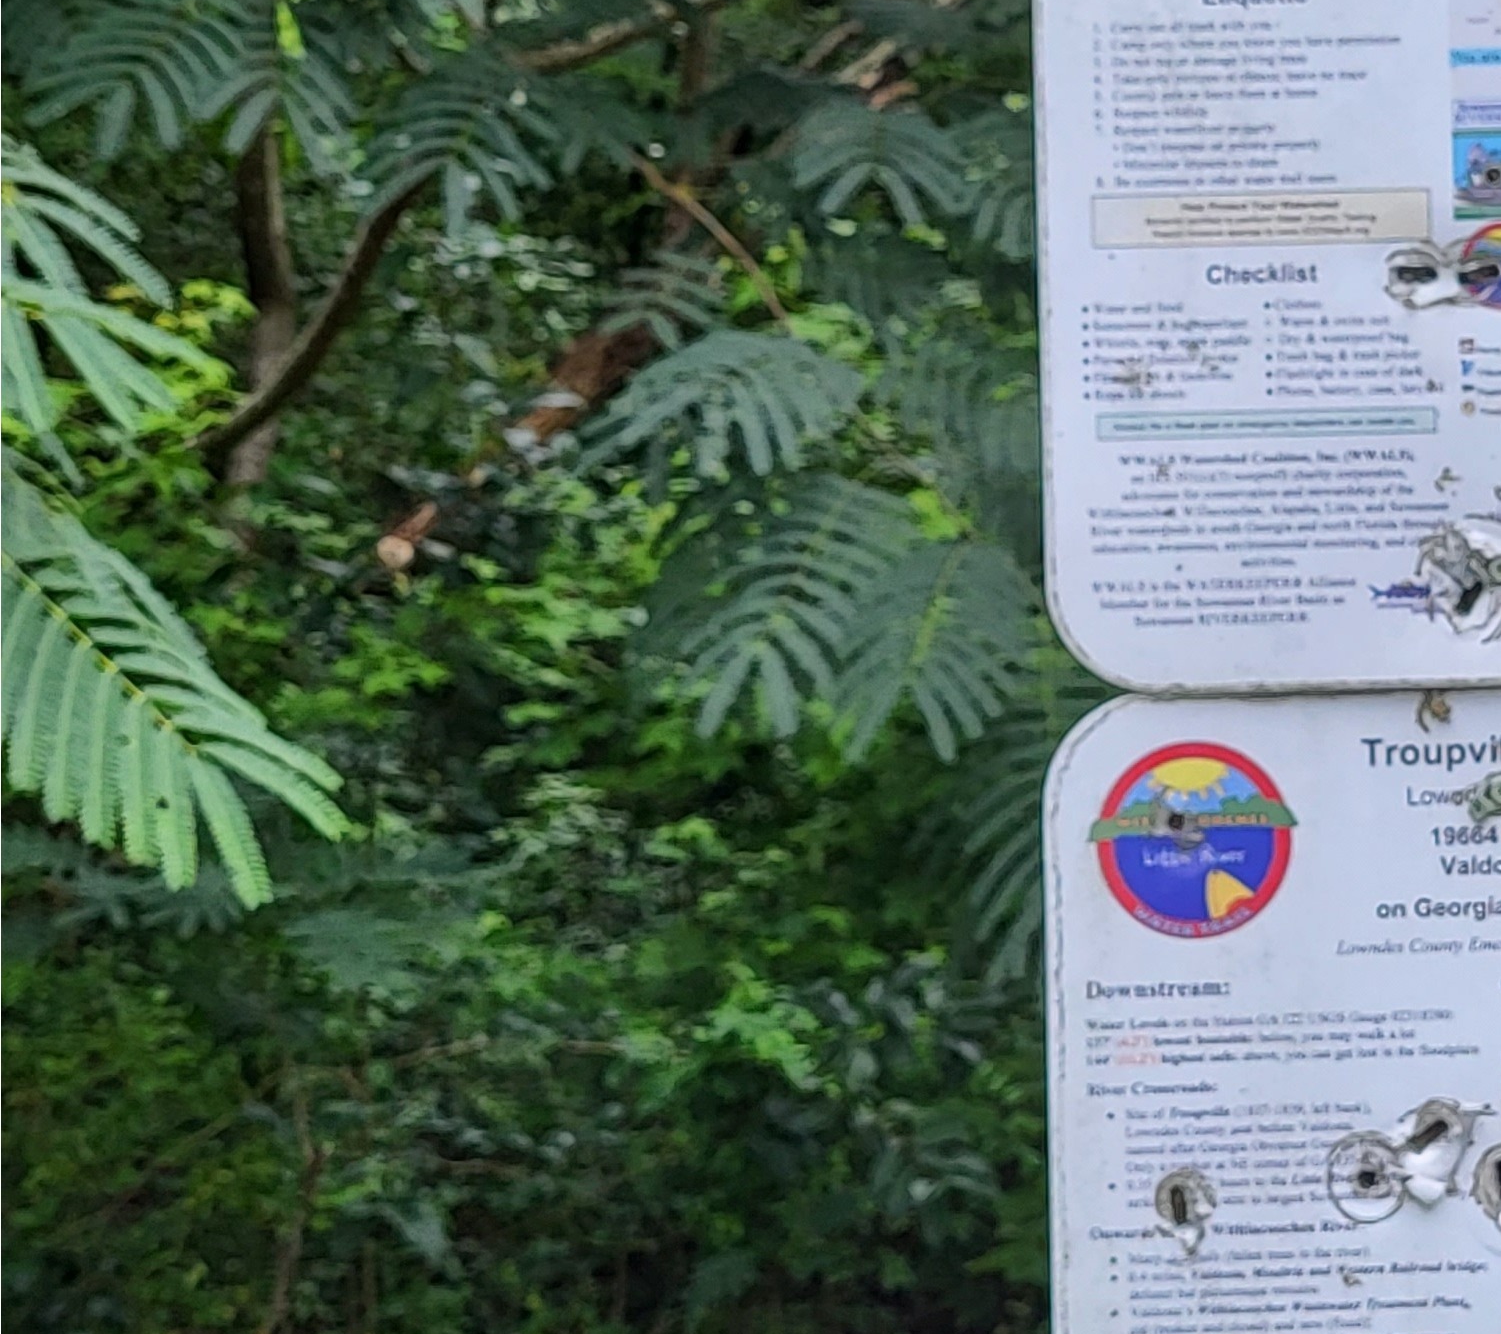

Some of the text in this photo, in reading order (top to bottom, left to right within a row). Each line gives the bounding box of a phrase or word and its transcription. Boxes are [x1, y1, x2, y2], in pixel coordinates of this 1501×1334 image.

[1206, 263, 1319, 285] Checklist
[1431, 826, 1498, 846] 19664
[1376, 901, 1406, 919] on
[1336, 939, 1402, 957] Lowndes
[1408, 937, 1463, 956] County
[1086, 980, 1231, 1000] Downstream:
